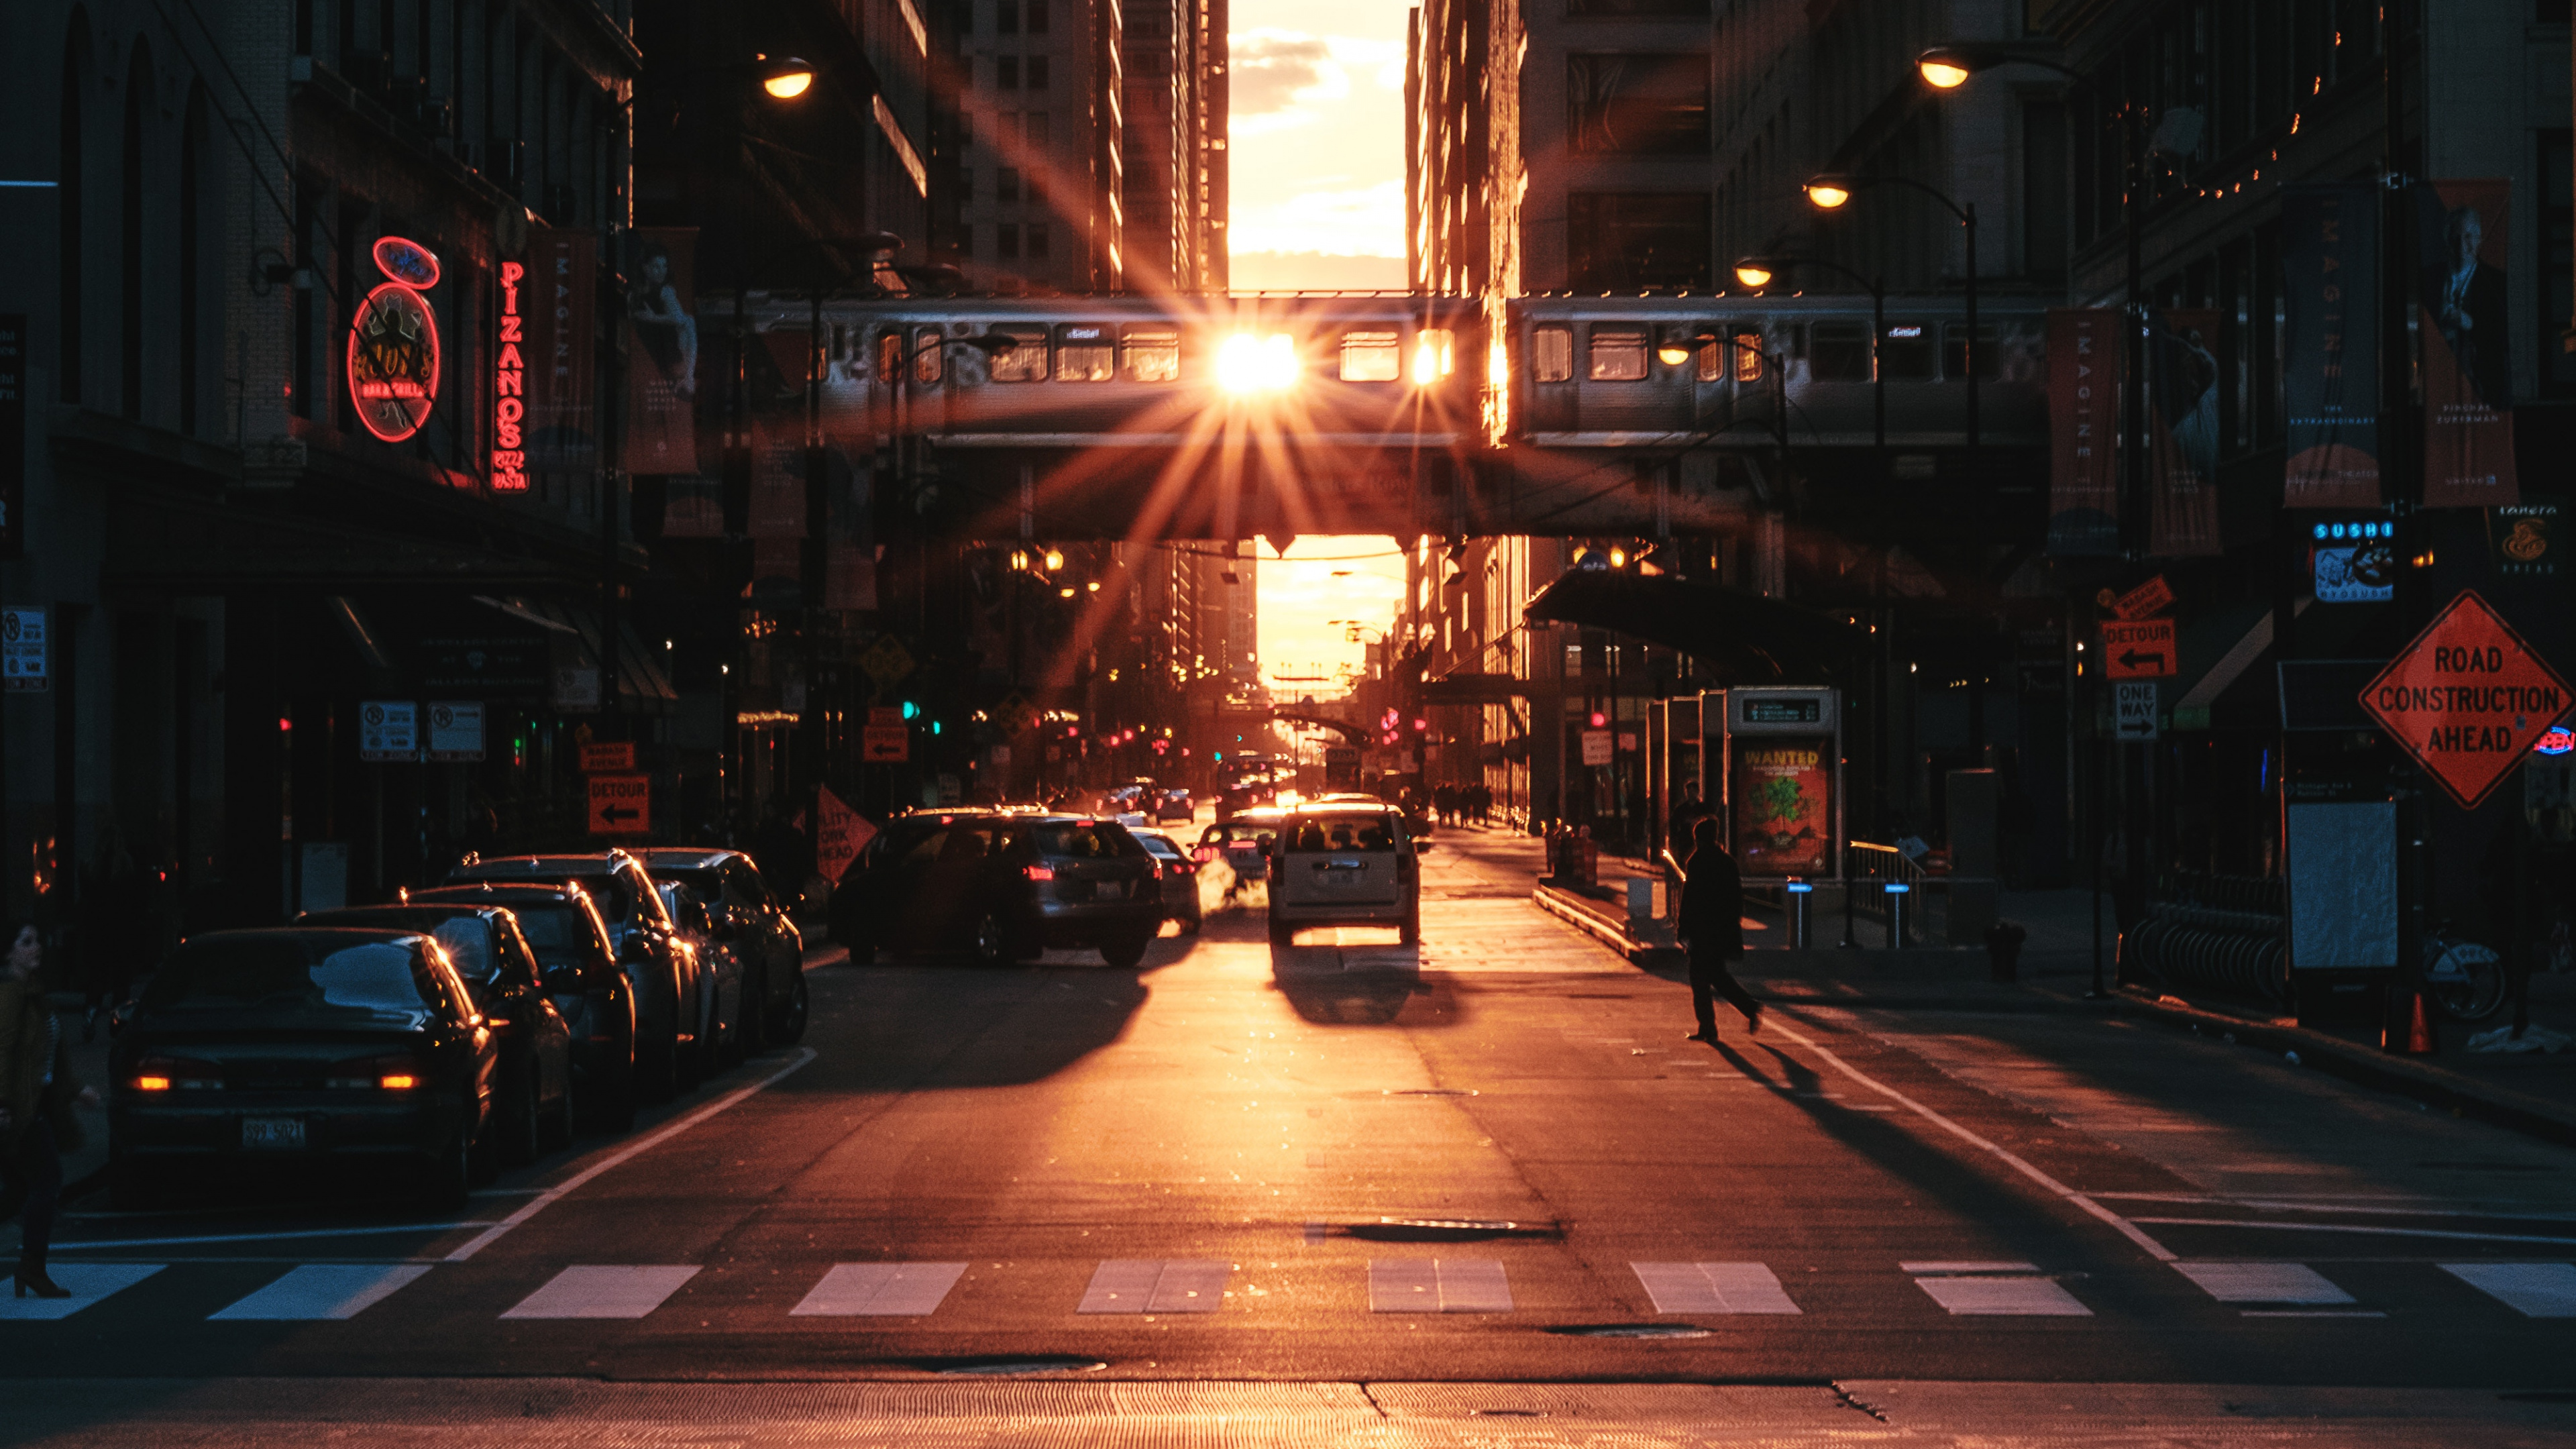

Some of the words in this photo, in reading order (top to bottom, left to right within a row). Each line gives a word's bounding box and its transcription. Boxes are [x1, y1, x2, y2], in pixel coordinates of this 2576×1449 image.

[2322, 200, 2341, 379] IMAGINE
[556, 242, 570, 378] IMAGINE
[497, 262, 525, 449] PIZANOS
[2077, 321, 2091, 458] IMAGINE
[2290, 417, 2375, 425] EXTRAORDINARY
[2436, 415, 2500, 424] ZUKERMAN
[2316, 523, 2390, 539] SUSHI
[2106, 627, 2171, 644] DETOUR
[2434, 646, 2503, 673] ROAD
[2120, 685, 2153, 701] ONE
[2379, 687, 2560, 713] CONSTRUCTION
[2121, 703, 2154, 718] WAY
[2428, 726, 2512, 752] AHEAD
[1745, 750, 1819, 765] WANTED
[592, 782, 645, 798] DETOUR
[818, 812, 851, 827] ILITY
[821, 830, 848, 843] ORK
[818, 847, 853, 861] HEAD
